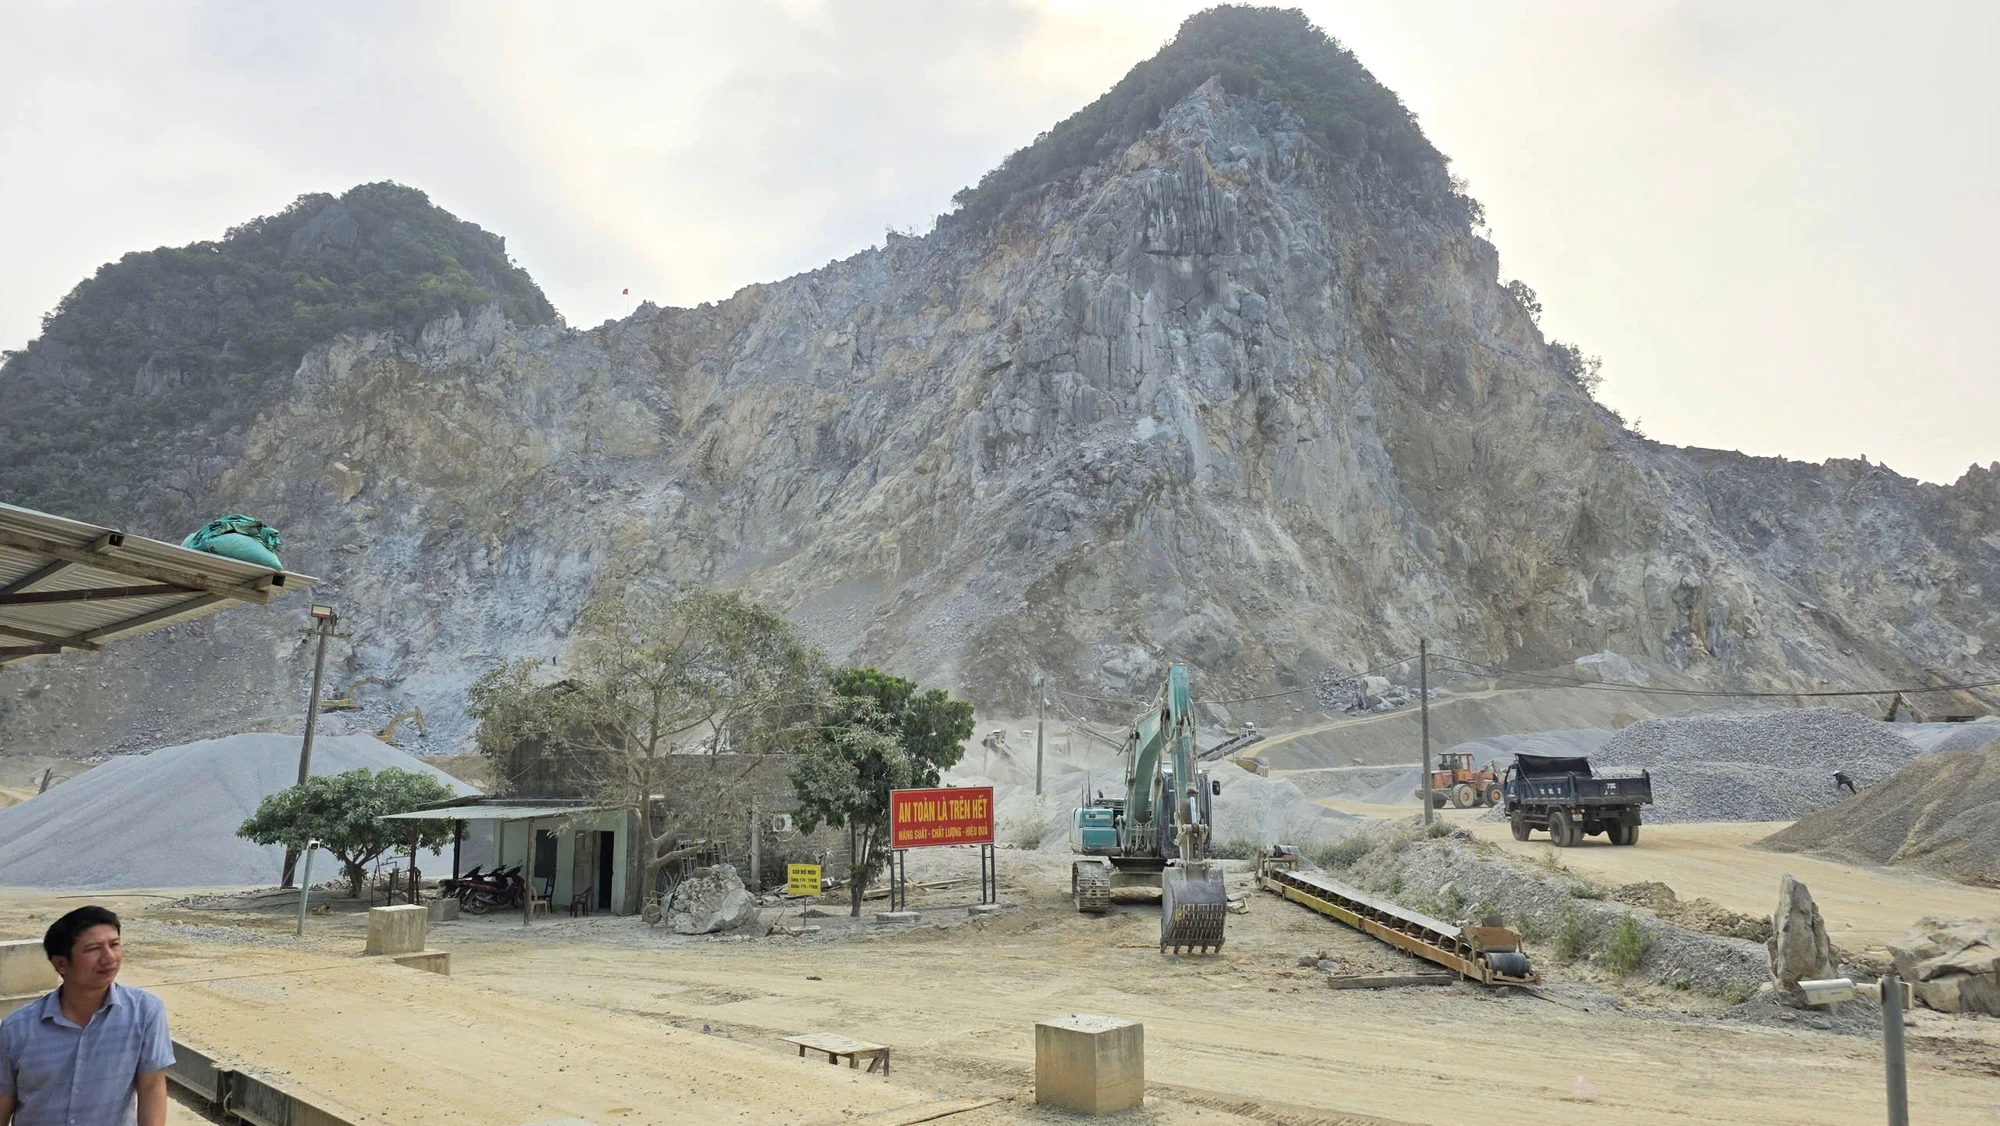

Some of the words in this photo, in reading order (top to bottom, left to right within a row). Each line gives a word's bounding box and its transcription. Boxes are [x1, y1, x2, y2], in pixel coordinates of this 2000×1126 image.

[899, 802, 911, 823] AN
[913, 796, 935, 823] TOÀN
[937, 796, 948, 821] LÀ
[949, 795, 970, 820] TRÊN
[972, 794, 987, 819] HẾT
